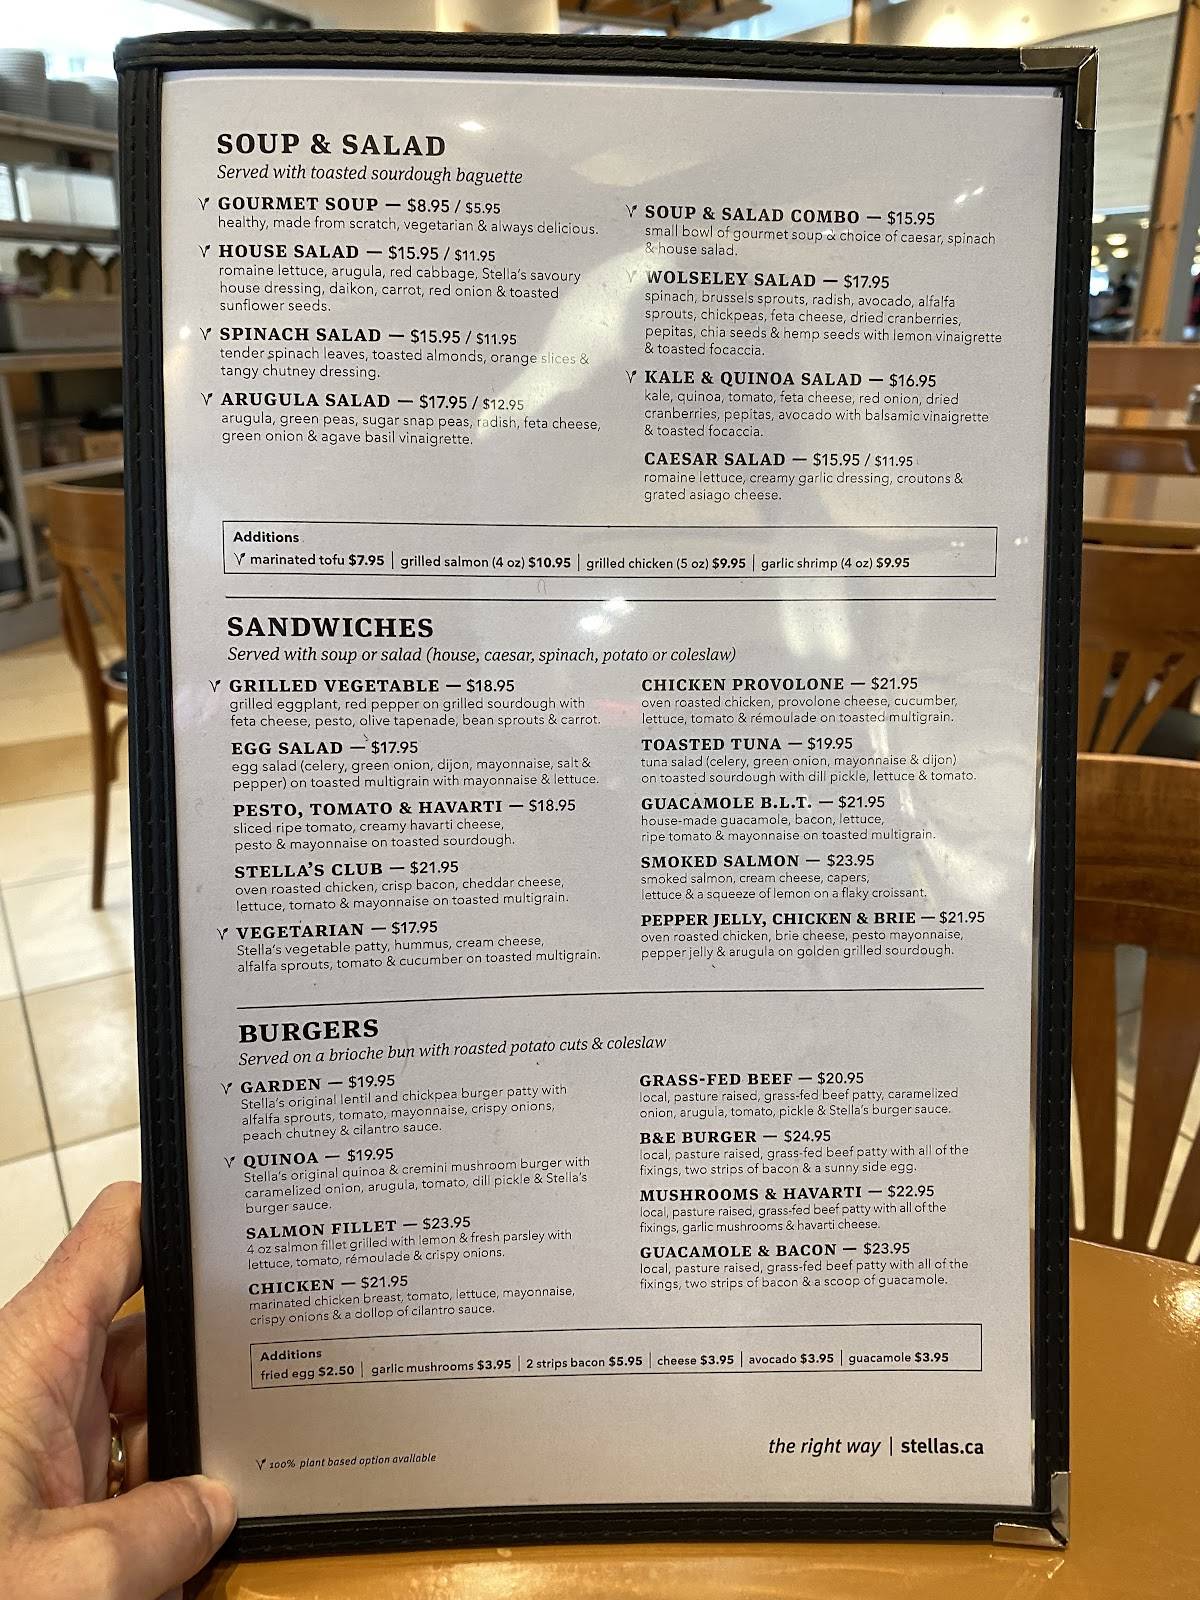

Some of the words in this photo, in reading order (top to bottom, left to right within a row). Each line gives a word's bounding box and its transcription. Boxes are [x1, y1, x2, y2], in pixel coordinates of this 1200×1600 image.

[217, 133, 299, 154] SOUP
[310, 133, 332, 154] &
[342, 134, 445, 156] SALAD
[217, 164, 269, 179] Served
[273, 164, 306, 179] with
[311, 165, 367, 180] toasted
[371, 166, 451, 185] sourdough
[456, 167, 523, 186] baguette
[218, 196, 319, 211] GOURMET
[325, 197, 378, 211] SOUP
[407, 198, 450, 213] $8.95
[466, 202, 500, 214] $5.95
[645, 205, 696, 220] SOUP
[702, 207, 716, 220] &
[722, 207, 784, 222] SALAD
[791, 209, 859, 224] COMBO
[887, 210, 935, 226] $15.95
[218, 215, 269, 232] healthy,
[273, 215, 311, 228] made
[314, 215, 345, 229] from
[349, 217, 400, 231] scratch,
[403, 219, 473, 234] vegetarian
[477, 219, 487, 232] &
[491, 220, 533, 236] always
[537, 221, 598, 235] delicious.
[646, 270, 748, 286] WOLSELEY
[754, 273, 816, 287] SALAD
[844, 274, 889, 289] $17.95
[220, 298, 285, 311] sunflower
[288, 298, 331, 312] seeds.
[220, 366, 259, 380] tangy
[262, 363, 316, 380] chutney
[319, 364, 380, 381] dressing.
[220, 392, 320, 407] ARUGULA
[325, 393, 390, 408] SALAD
[419, 394, 467, 409] $17.95
[483, 398, 524, 410] $12.95
[644, 452, 718, 466] CAESAR
[724, 452, 785, 466] SALAD
[813, 452, 860, 467] $15.95
[874, 455, 913, 467] $11.95
[644, 488, 686, 503] grated
[689, 488, 731, 503] asiago
[734, 488, 782, 500] cheese.
[233, 531, 299, 543] Additions
[250, 553, 316, 565] marinated
[319, 554, 345, 565] tofu
[348, 554, 384, 567] $7.95
[400, 555, 441, 569] grilled
[444, 555, 489, 567] salmon
[492, 556, 504, 569] (4
[507, 556, 525, 570] oz)
[528, 556, 571, 568] $10.95
[586, 557, 625, 571] grilled
[628, 557, 673, 569] chicken
[676, 558, 688, 570] (5
[691, 558, 709, 570] oz)
[712, 557, 746, 570] $9.95
[228, 617, 433, 638] SANDWICHES
[228, 646, 280, 661] Served
[284, 646, 317, 661] with
[321, 650, 357, 664] soup
[361, 650, 378, 661] or
[381, 647, 422, 661] salad
[426, 646, 479, 664] (house,
[484, 651, 535, 664] caesar,
[538, 648, 598, 665] spinach,
[601, 649, 648, 665] potato
[652, 651, 667, 661] or
[670, 647, 736, 663] coleslaw)
[642, 678, 726, 692] CHICKEN
[732, 678, 844, 691] PROVOLONE
[871, 677, 918, 691] $21.95
[231, 742, 272, 755] EGG
[278, 741, 343, 755] SALAD
[371, 740, 418, 755] $17.95
[233, 803, 303, 819] PESTO,
[309, 802, 392, 816] TOMATO
[399, 801, 412, 815] &
[418, 800, 502, 814] HAVARTI
[529, 799, 575, 812] $18.95
[641, 797, 754, 810] GUACAMOLE
[760, 796, 812, 809] B.L.T.
[838, 795, 885, 809] $21.95
[641, 814, 717, 826] house-made
[720, 813, 791, 828] guacamole,
[795, 813, 836, 826] bacon,
[839, 813, 884, 826] lettuce,
[641, 914, 709, 927] PEPPER
[712, 913, 767, 928] JELLY,
[772, 912, 852, 925] CHICKEN
[856, 912, 869, 925] &
[873, 912, 916, 924] BRIE
[939, 911, 985, 924] $21.95
[238, 1019, 378, 1043] BURGERS
[238, 1050, 289, 1066] Served
[293, 1053, 311, 1064] on
[315, 1052, 325, 1062] a
[329, 1046, 384, 1062] brioche
[387, 1045, 415, 1059] bun
[419, 1043, 449, 1057] with
[454, 1040, 507, 1055] roasted
[509, 1040, 556, 1056] potato
[559, 1038, 588, 1051] cuts
[591, 1037, 604, 1050] &
[607, 1035, 667, 1050] coleslaw
[241, 1078, 321, 1094] GARDEN
[348, 1074, 395, 1089] $19.95
[640, 1073, 741, 1087] GRASS-FED
[747, 1073, 793, 1085] BEEF
[817, 1072, 864, 1085] $20.95
[243, 1128, 282, 1143] peach
[286, 1127, 337, 1140] chutney
[340, 1125, 350, 1136] &
[353, 1123, 400, 1135] cilantro
[403, 1123, 442, 1133] sauce.
[640, 1132, 676, 1144] B&E
[681, 1131, 757, 1144] BURGER
[784, 1130, 831, 1143] $24.95
[243, 1152, 319, 1169] QUINOA
[347, 1148, 394, 1163] $19.95
[640, 1188, 759, 1202] MUSHROOMS
[765, 1188, 777, 1200] &
[782, 1186, 861, 1200] HAVARTI
[887, 1185, 934, 1198] $22.95
[246, 1203, 289, 1215] burger
[292, 1201, 332, 1211] sauce.
[640, 1245, 752, 1259] GUACAMOLE
[758, 1245, 770, 1257] &
[775, 1244, 837, 1257] BACON
[863, 1242, 910, 1256] $23.95
[260, 1349, 322, 1362] Additions
[657, 1355, 697, 1366] cheese
[700, 1355, 734, 1366] $3.95
[749, 1353, 797, 1364] avocado
[800, 1353, 834, 1364] $3.95
[848, 1352, 911, 1366] guacamole
[914, 1352, 949, 1363] $3.95
[260, 1368, 288, 1380] fried
[292, 1370, 315, 1380] egg
[318, 1365, 354, 1377] $2.50
[769, 1437, 796, 1454] the
[801, 1437, 842, 1457] right
[847, 1441, 882, 1457] way
[901, 1437, 984, 1454] stellas.ca
[269, 1459, 296, 1469] 100%
[299, 1458, 325, 1470] plant
[327, 1456, 357, 1467] based
[359, 1455, 390, 1467] option
[392, 1453, 436, 1463] available
